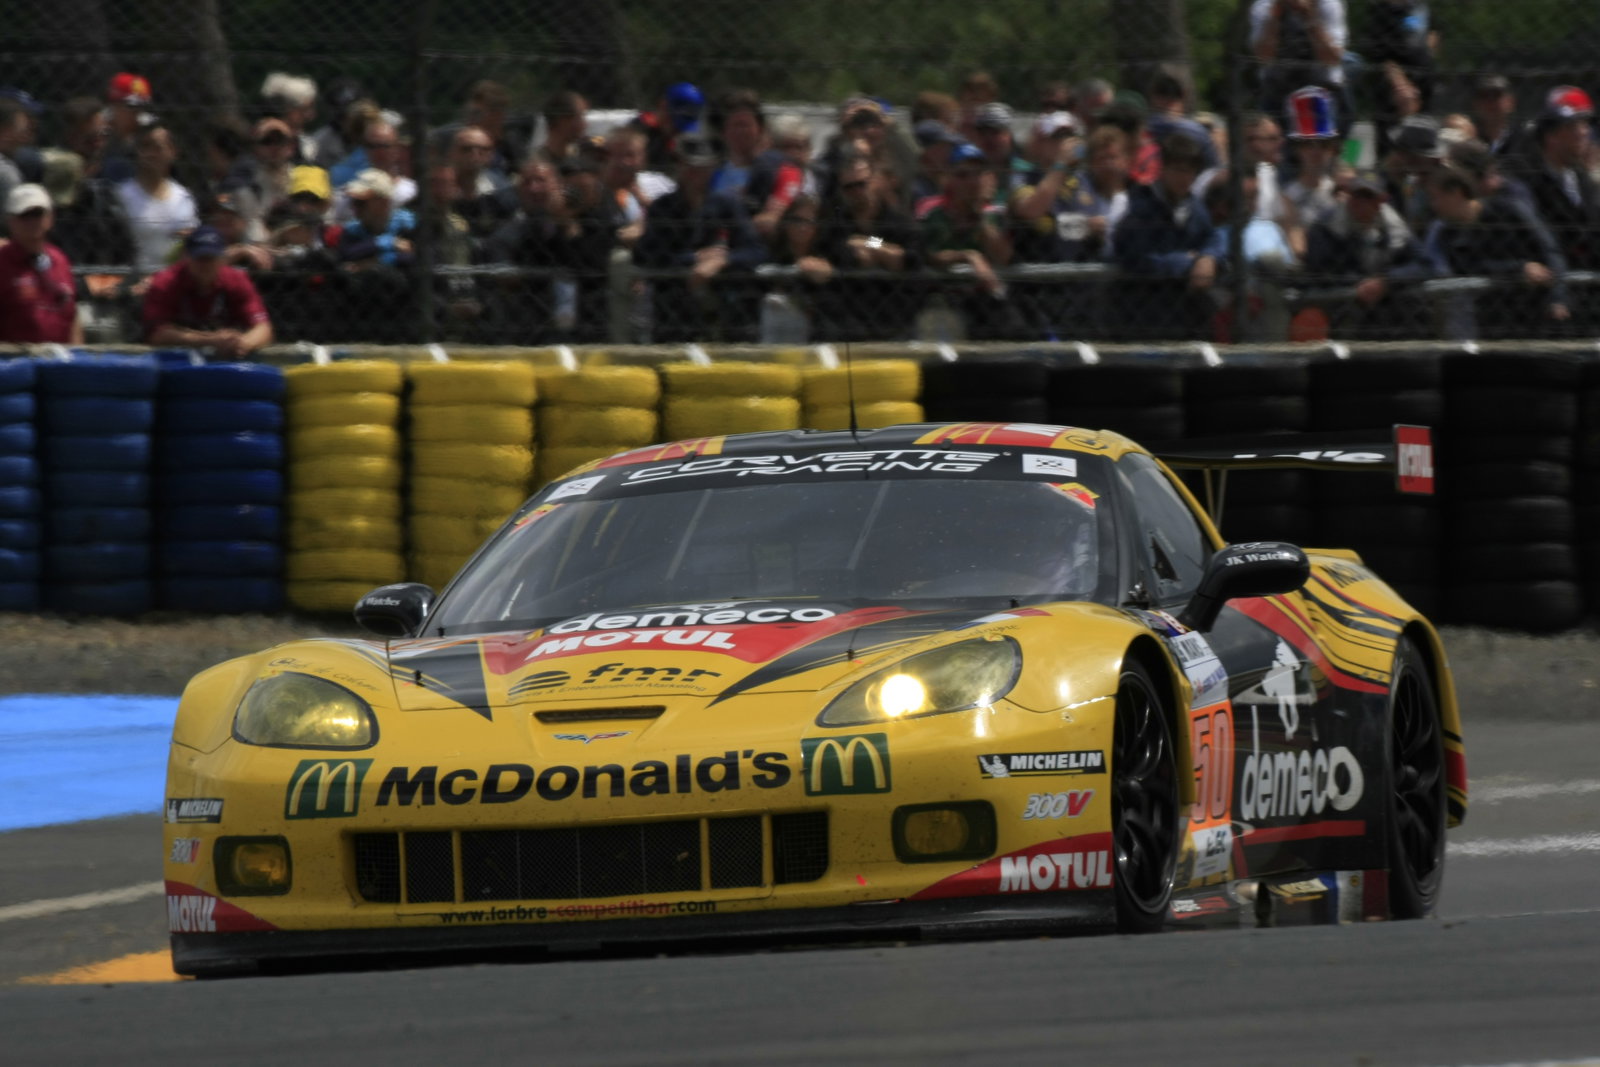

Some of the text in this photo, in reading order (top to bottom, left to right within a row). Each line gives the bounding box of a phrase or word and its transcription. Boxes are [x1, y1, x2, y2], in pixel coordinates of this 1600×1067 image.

[627, 449, 1000, 481] CORVETTE
[736, 460, 985, 477] RACING
[549, 606, 836, 635] demeco
[524, 629, 737, 661] MOTUL
[582, 662, 723, 684] fmr
[1009, 750, 1102, 770] MICHELIN
[1192, 709, 1231, 824] 50
[1240, 704, 1365, 822] demeco
[374, 749, 792, 807] McDonald's
[1022, 788, 1096, 820] 300V
[999, 850, 1113, 892] MOTUL
[166, 895, 217, 932] MOTUL
